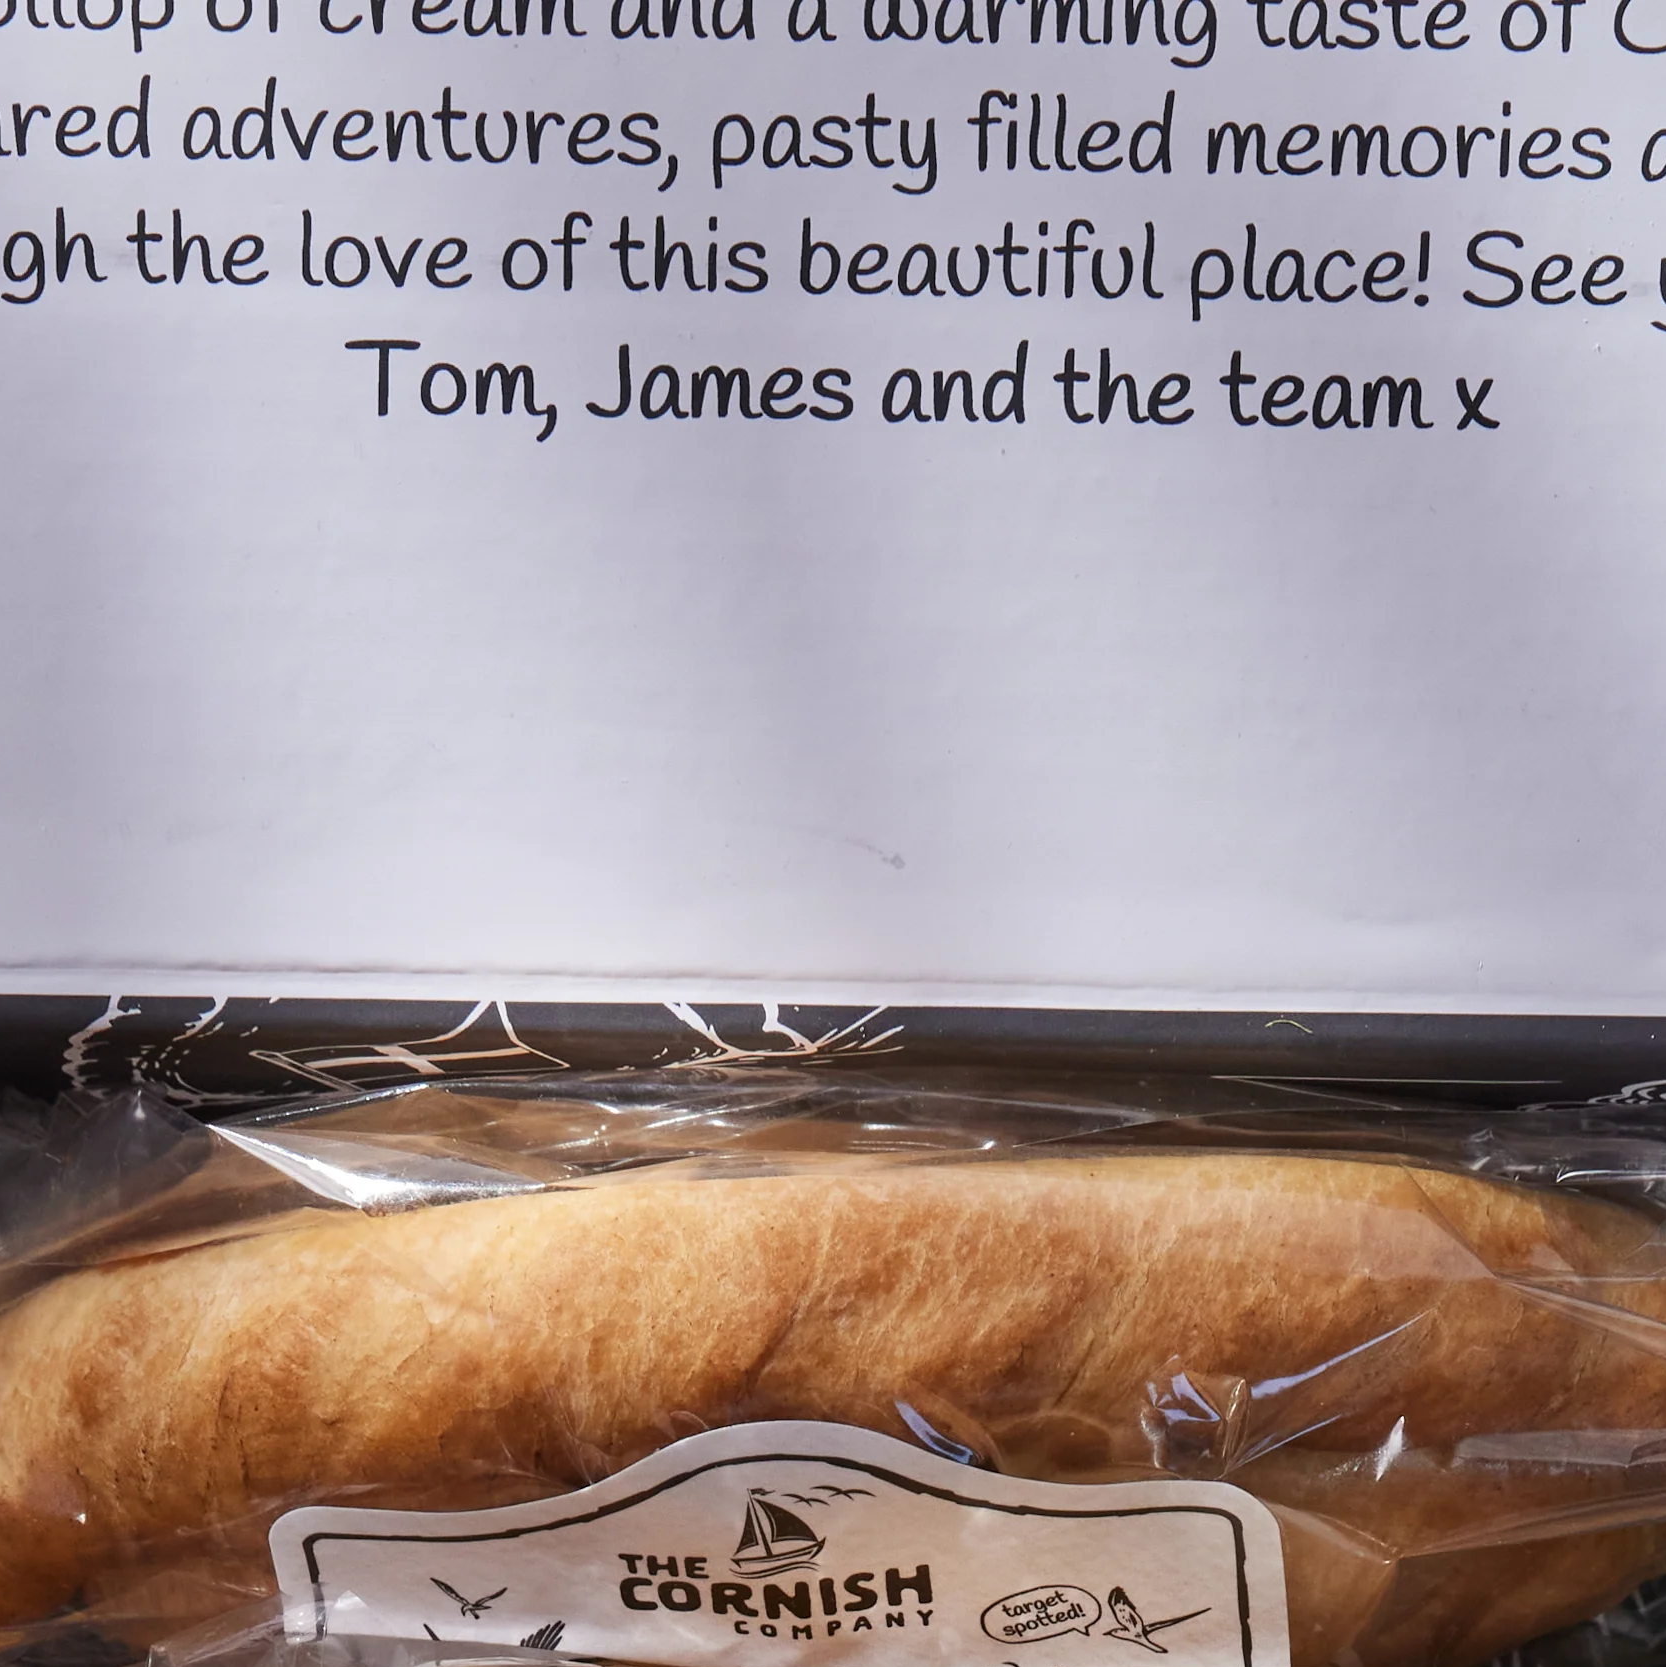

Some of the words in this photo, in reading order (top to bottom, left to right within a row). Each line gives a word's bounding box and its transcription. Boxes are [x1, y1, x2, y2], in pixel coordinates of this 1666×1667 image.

[184, 77, 677, 192] adventures,
[713, 93, 937, 194] pasty
[967, 90, 1175, 173] filled
[1208, 102, 1611, 179] memories
[126, 206, 268, 290] the
[303, 210, 472, 288] love
[501, 212, 592, 293] of
[609, 212, 768, 293] this
[800, 218, 1163, 299] beautiful
[1191, 223, 1430, 321] place!
[1463, 231, 1627, 308] See
[345, 340, 557, 442] Tom,
[586, 344, 853, 421] James
[882, 340, 1028, 423] and
[1053, 348, 1194, 425] the
[1220, 351, 1433, 429] team
[1456, 378, 1500, 430] x
[619, 1553, 708, 1580] THE
[618, 1563, 933, 1617] CORNISH
[1002, 1591, 1068, 1617] target
[733, 1610, 933, 1639] COMPANY
[1003, 1603, 1086, 1637] spotted!
